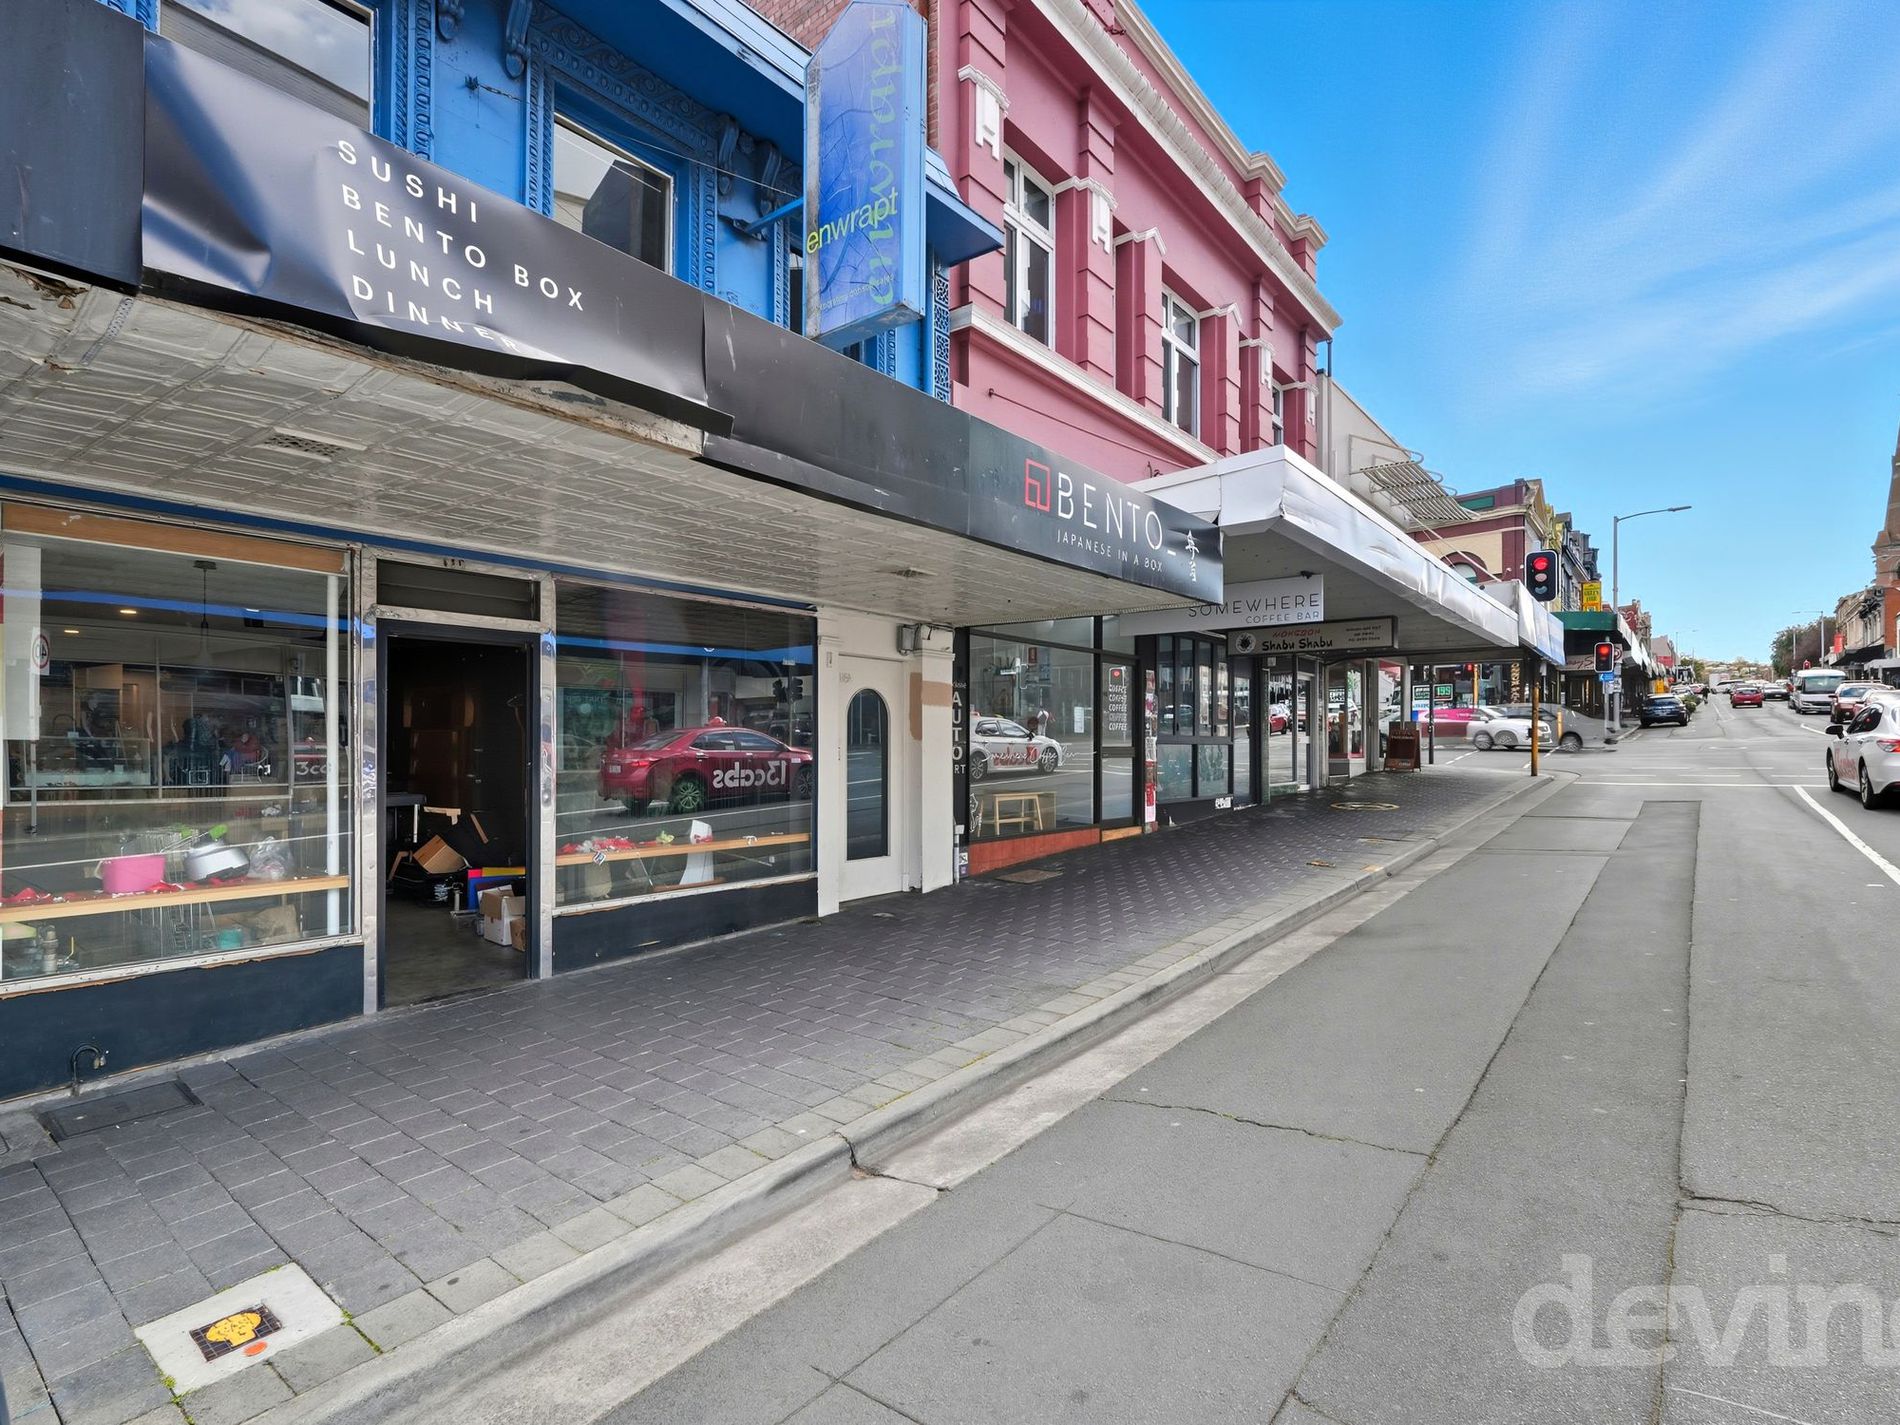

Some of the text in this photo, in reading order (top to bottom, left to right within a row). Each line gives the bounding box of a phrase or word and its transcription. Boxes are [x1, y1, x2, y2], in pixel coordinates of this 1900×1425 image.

[338, 140, 477, 223] SUSHI
[342, 184, 583, 311] BENTO BOX
[806, 186, 898, 254] enwrapt
[347, 229, 493, 314] LUNCH
[1057, 529, 1163, 573] JAPANESE IN A BOX
[1188, 593, 1320, 618] SOMEWHERE
[1246, 611, 1320, 625] COFFEE BAR
[1261, 637, 1333, 651] Shabu Shabu
